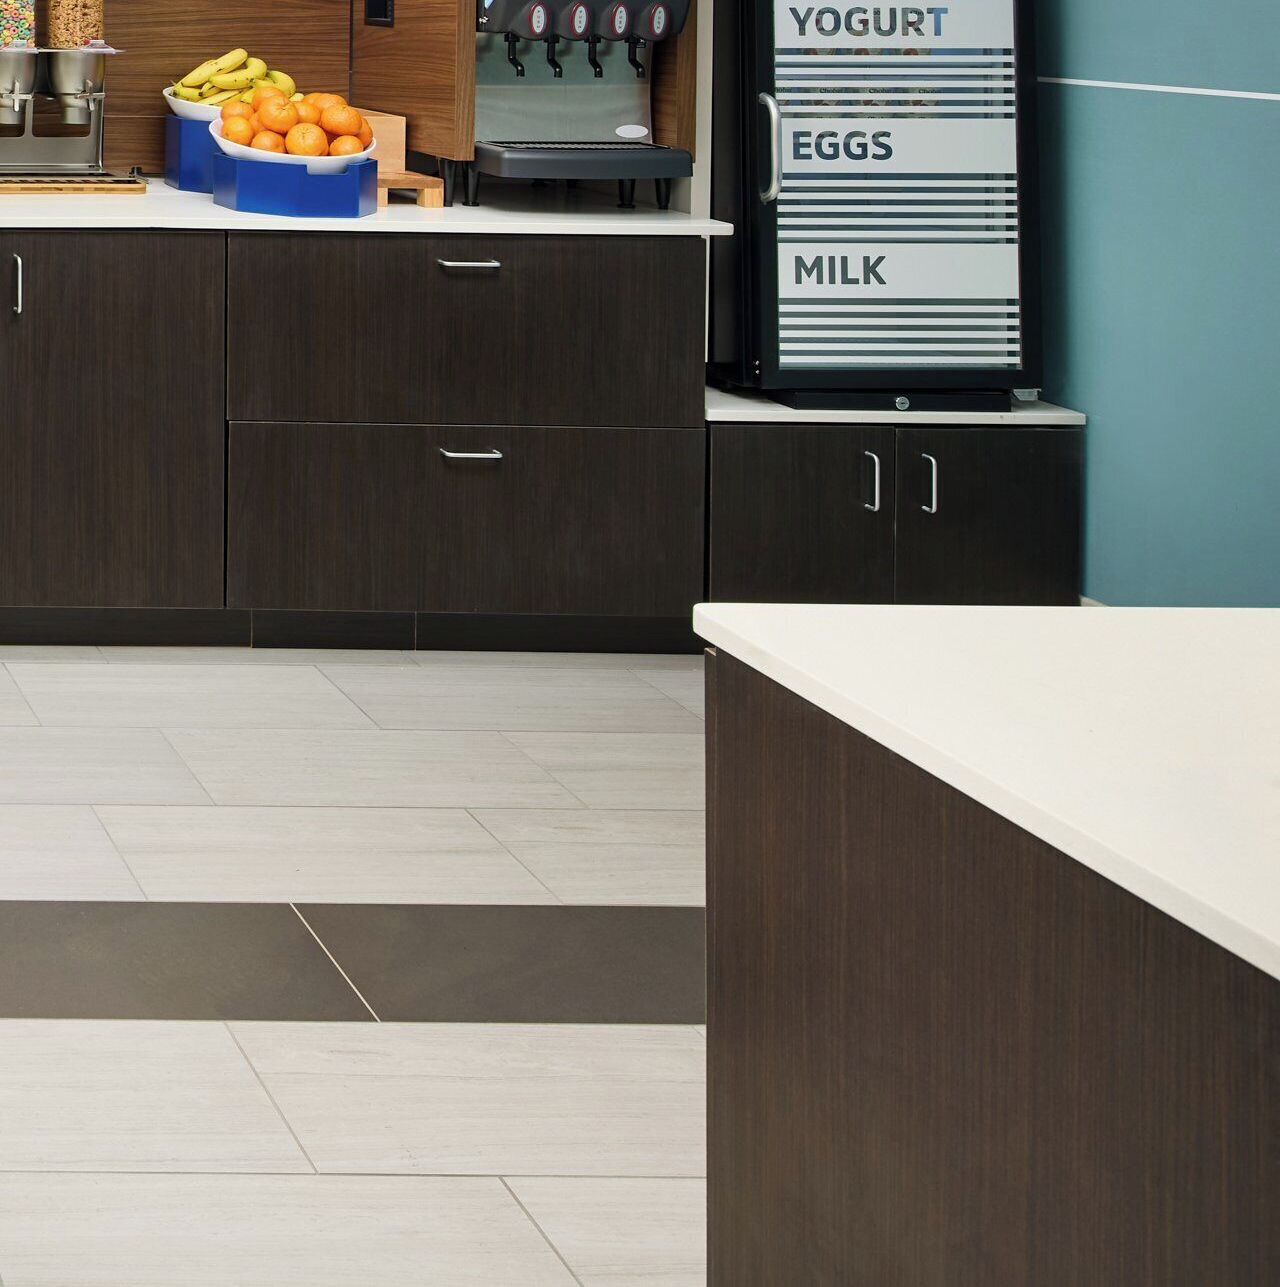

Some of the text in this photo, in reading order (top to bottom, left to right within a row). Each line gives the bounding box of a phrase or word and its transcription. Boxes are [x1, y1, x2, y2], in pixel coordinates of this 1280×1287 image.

[789, 7, 949, 37] YOGURT
[792, 130, 893, 160] EGGS
[794, 255, 887, 285] MILK
